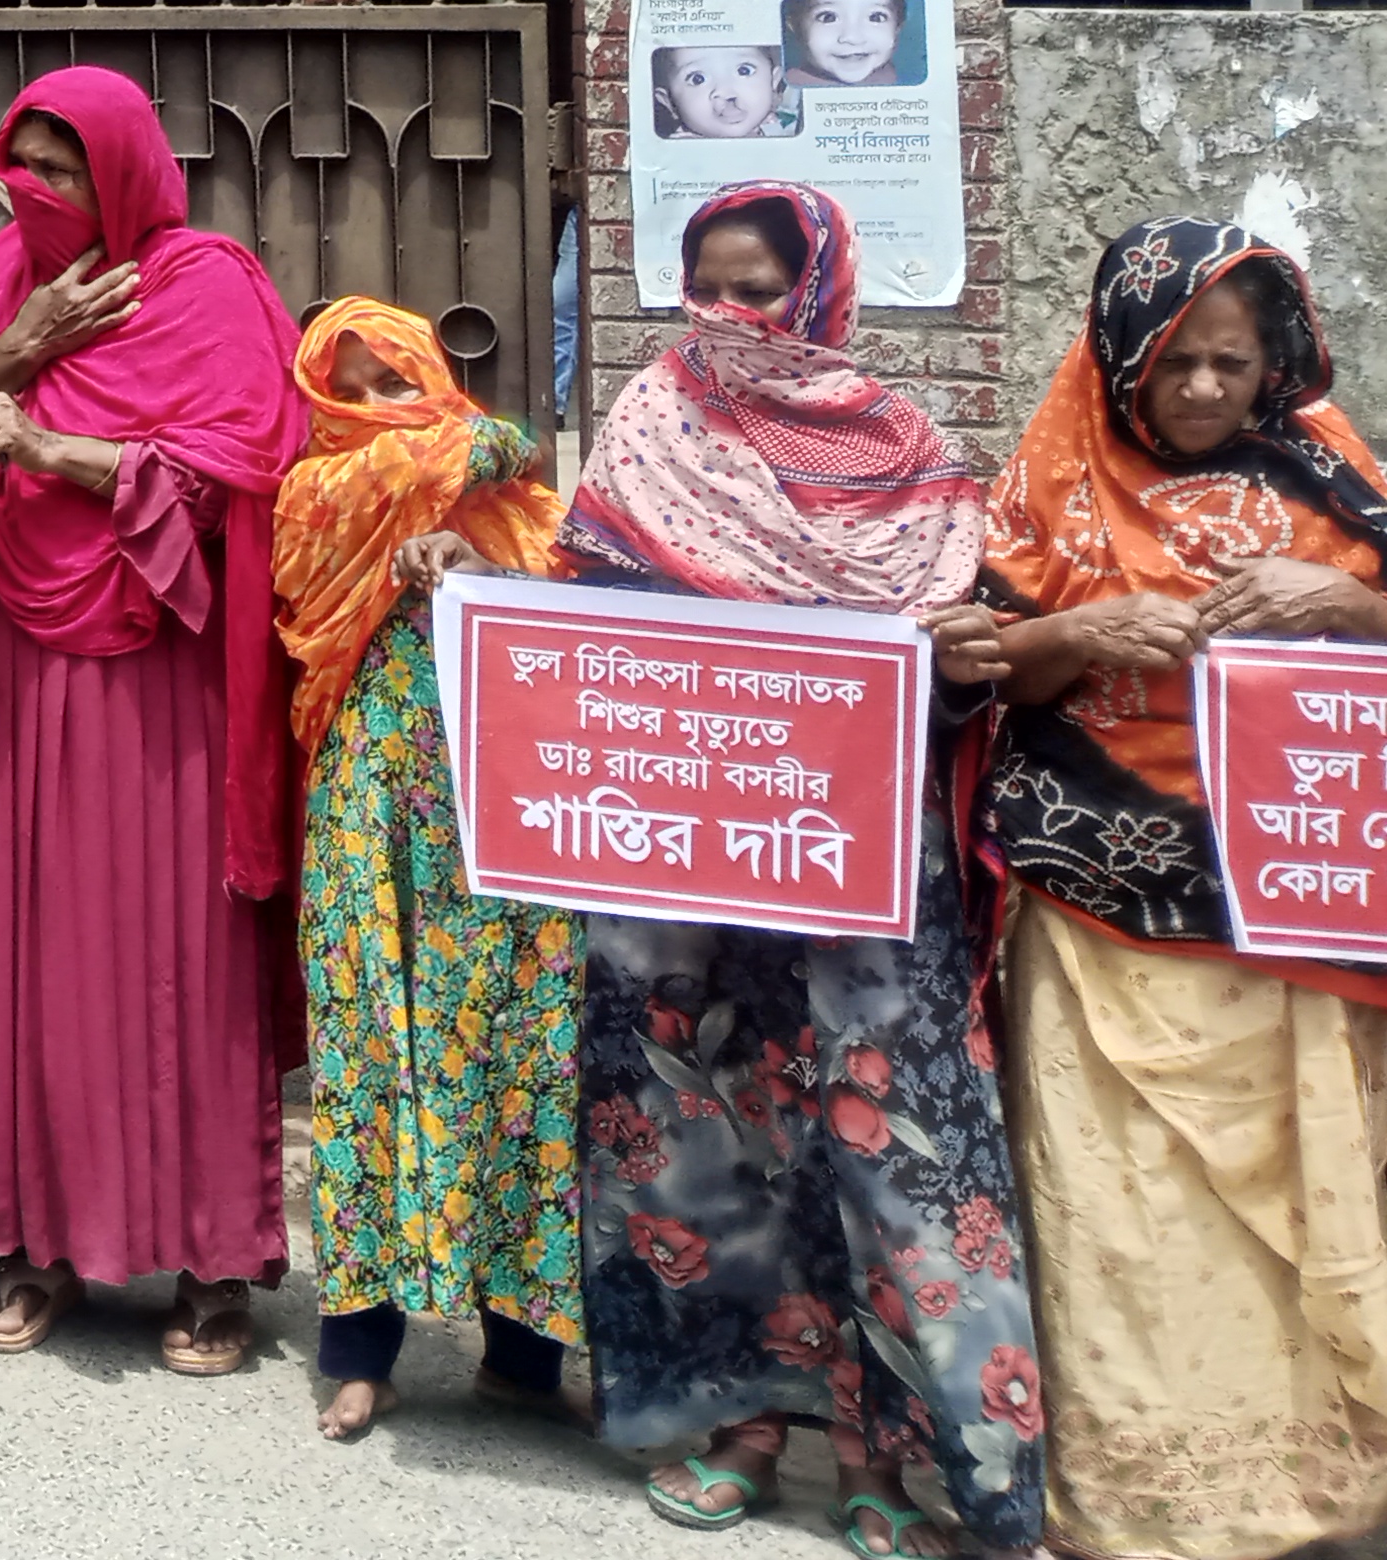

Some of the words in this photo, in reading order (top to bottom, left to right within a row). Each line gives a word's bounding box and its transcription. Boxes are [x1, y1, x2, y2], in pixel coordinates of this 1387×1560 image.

[507, 646, 566, 687] ভুল
[573, 642, 703, 695] চিকিৎসা
[710, 666, 867, 710] নবজাতক
[575, 688, 666, 737] শিশুর
[673, 709, 799, 763] মৃত্যুতে
[1292, 689, 1387, 736] আম
[534, 740, 592, 776] ডাঃ
[601, 748, 713, 791] রাবেয়া
[720, 749, 832, 802] বসরীর
[1282, 748, 1367, 806] ভুল
[512, 785, 703, 870] শাস্তির
[716, 808, 855, 890] দাবি
[1247, 802, 1346, 847] আর
[1257, 860, 1375, 907] কোল
